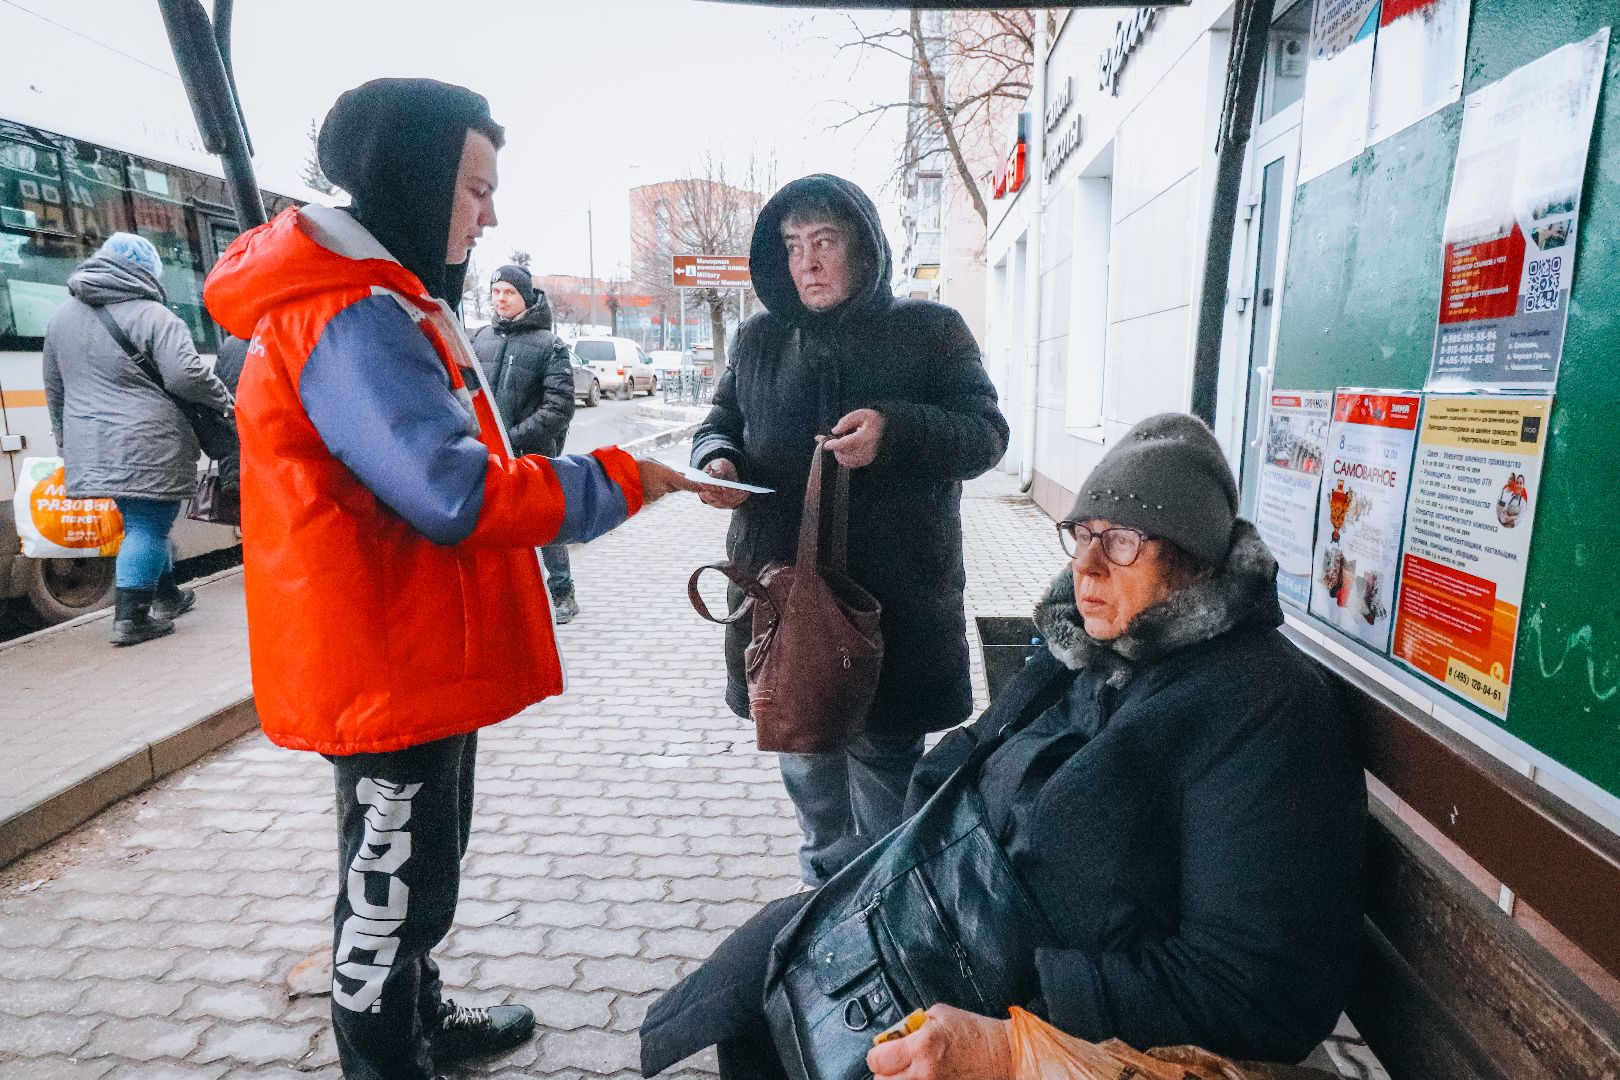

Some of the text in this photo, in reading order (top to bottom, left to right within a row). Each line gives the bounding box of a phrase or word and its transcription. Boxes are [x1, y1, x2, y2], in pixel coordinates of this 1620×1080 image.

[696, 258, 730, 266] Мемориал
[696, 272, 721, 280] Military
[1340, 434, 1345, 449] 8
[1333, 459, 1397, 488] САМОВАРНОЕ
[1453, 669, 1470, 686] (495)
[1471, 678, 1502, 701] 120-04-61
